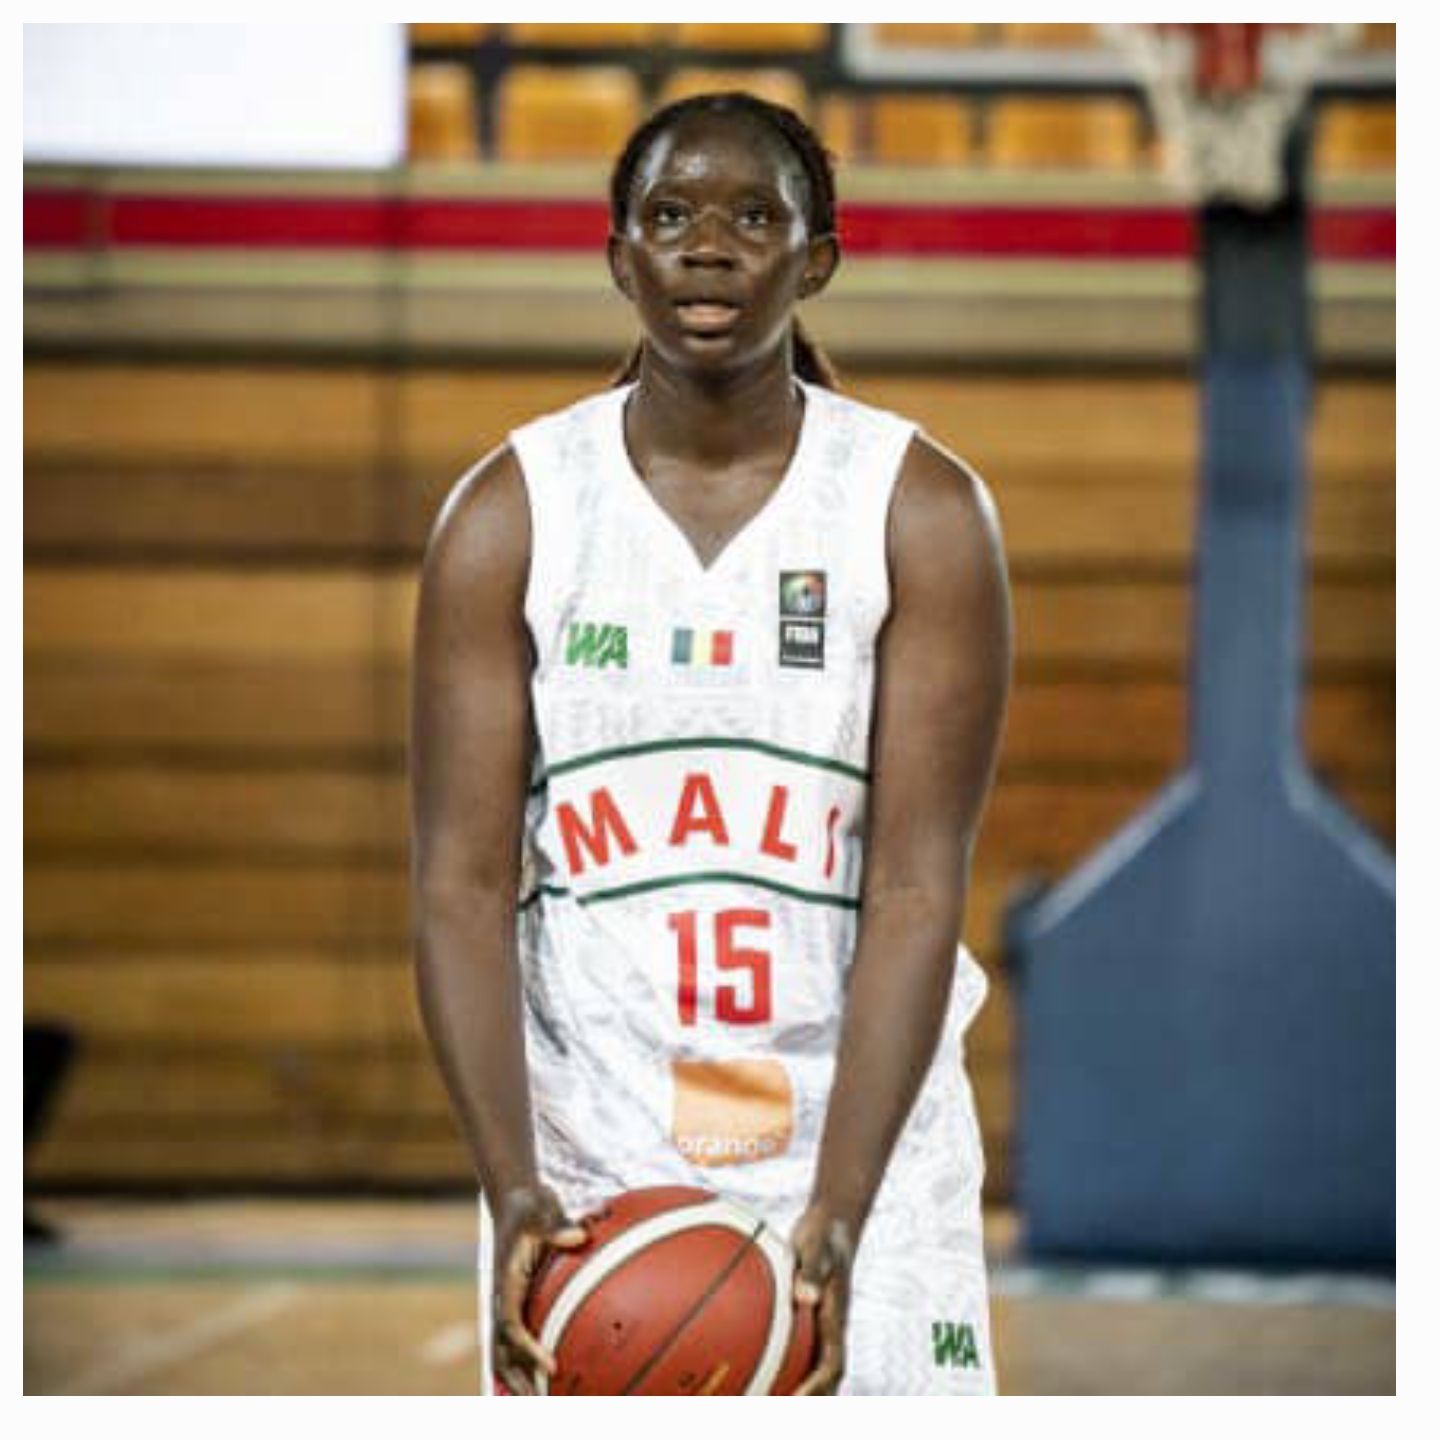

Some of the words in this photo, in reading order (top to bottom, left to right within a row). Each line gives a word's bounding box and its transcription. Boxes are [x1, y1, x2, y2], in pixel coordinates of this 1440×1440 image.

[564, 622, 628, 669] WA
[555, 773, 841, 879] MALI
[666, 908, 773, 1028] 15
